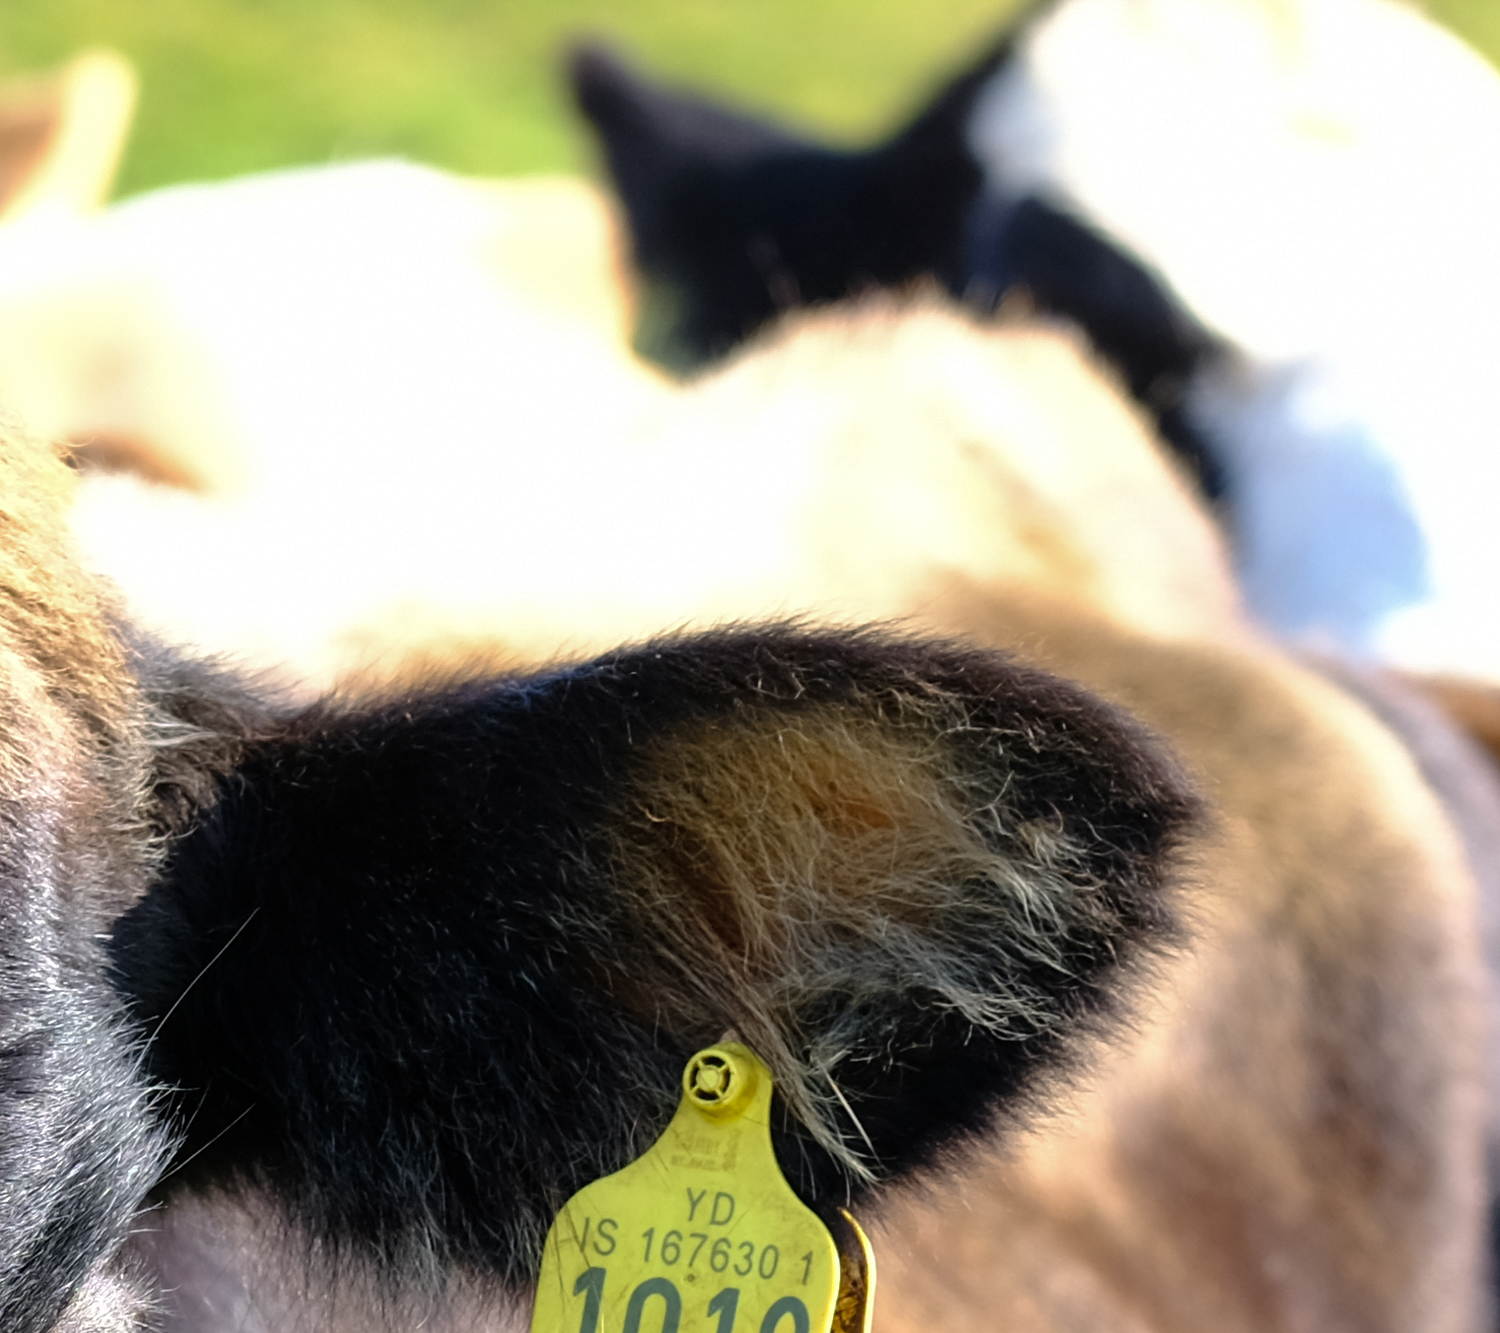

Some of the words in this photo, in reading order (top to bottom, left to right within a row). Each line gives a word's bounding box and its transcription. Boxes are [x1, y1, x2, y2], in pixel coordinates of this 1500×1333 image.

[686, 1187, 736, 1227] YD
[641, 1226, 780, 1281] 167630
[800, 1251, 815, 1286] 1
